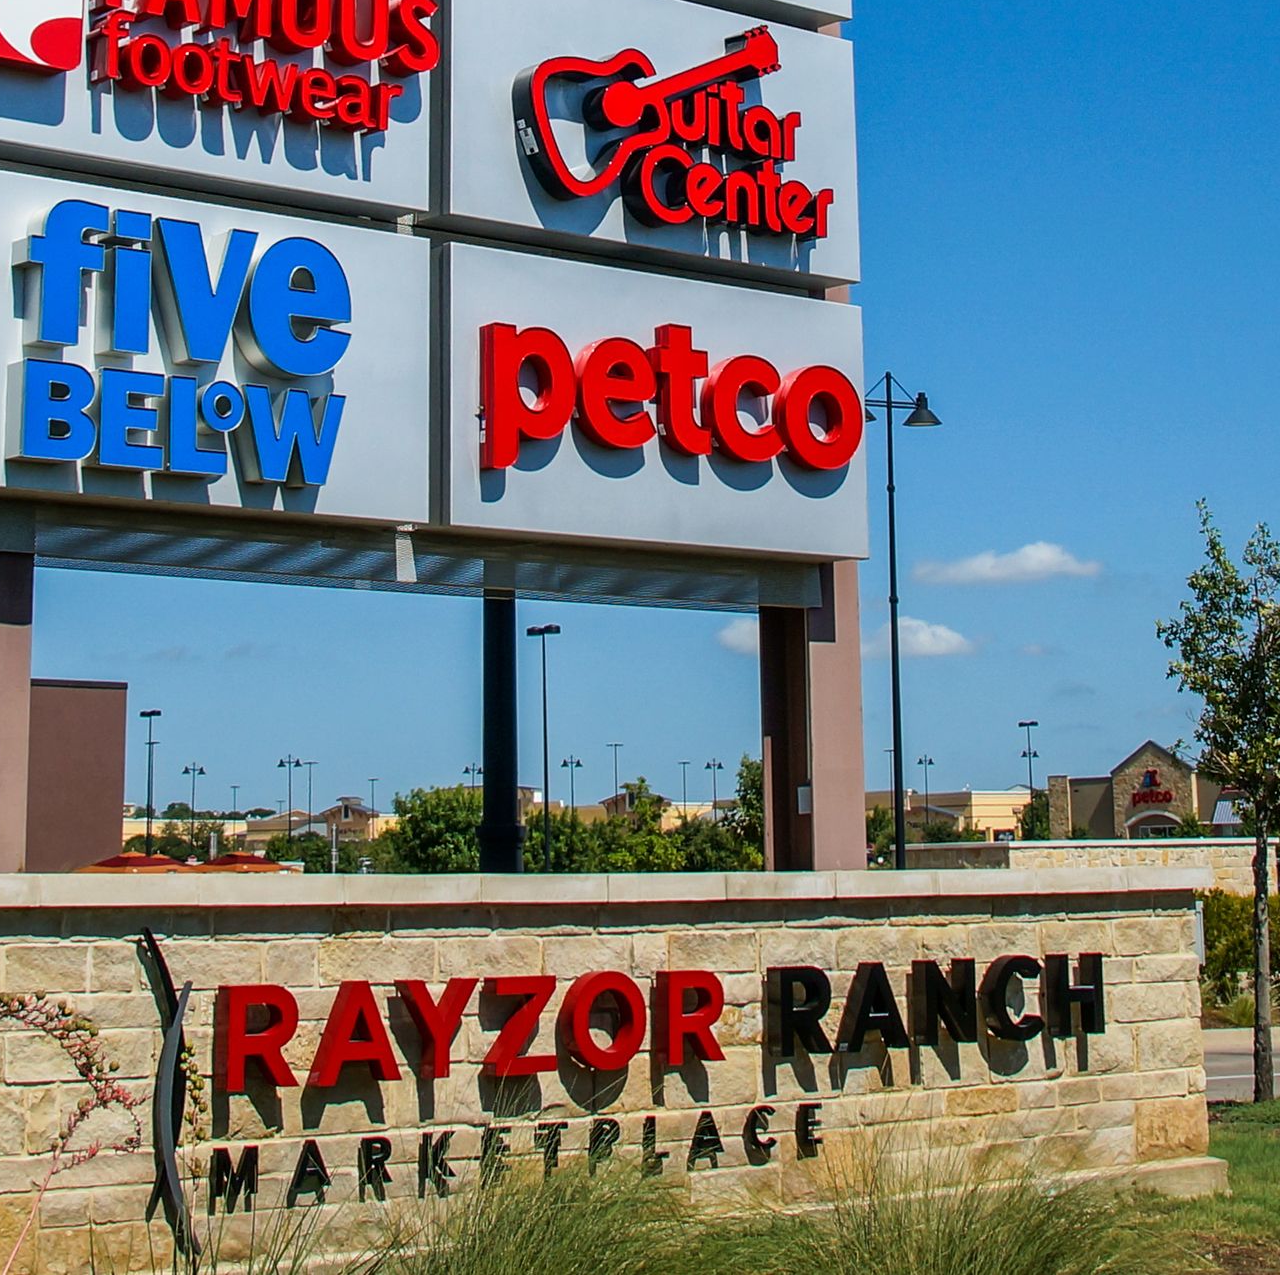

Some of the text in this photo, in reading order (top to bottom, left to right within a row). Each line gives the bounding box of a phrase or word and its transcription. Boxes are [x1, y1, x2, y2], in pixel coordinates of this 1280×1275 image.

[94, 9, 404, 133] footwear
[632, 144, 834, 239] Center
[18, 199, 352, 377] five
[10, 358, 347, 487] BELOW
[479, 321, 863, 471] petco
[1132, 788, 1173, 807] petco
[218, 952, 1105, 1093] RAYZOR RANCH
[210, 1102, 824, 1215] MARKETPLACE
